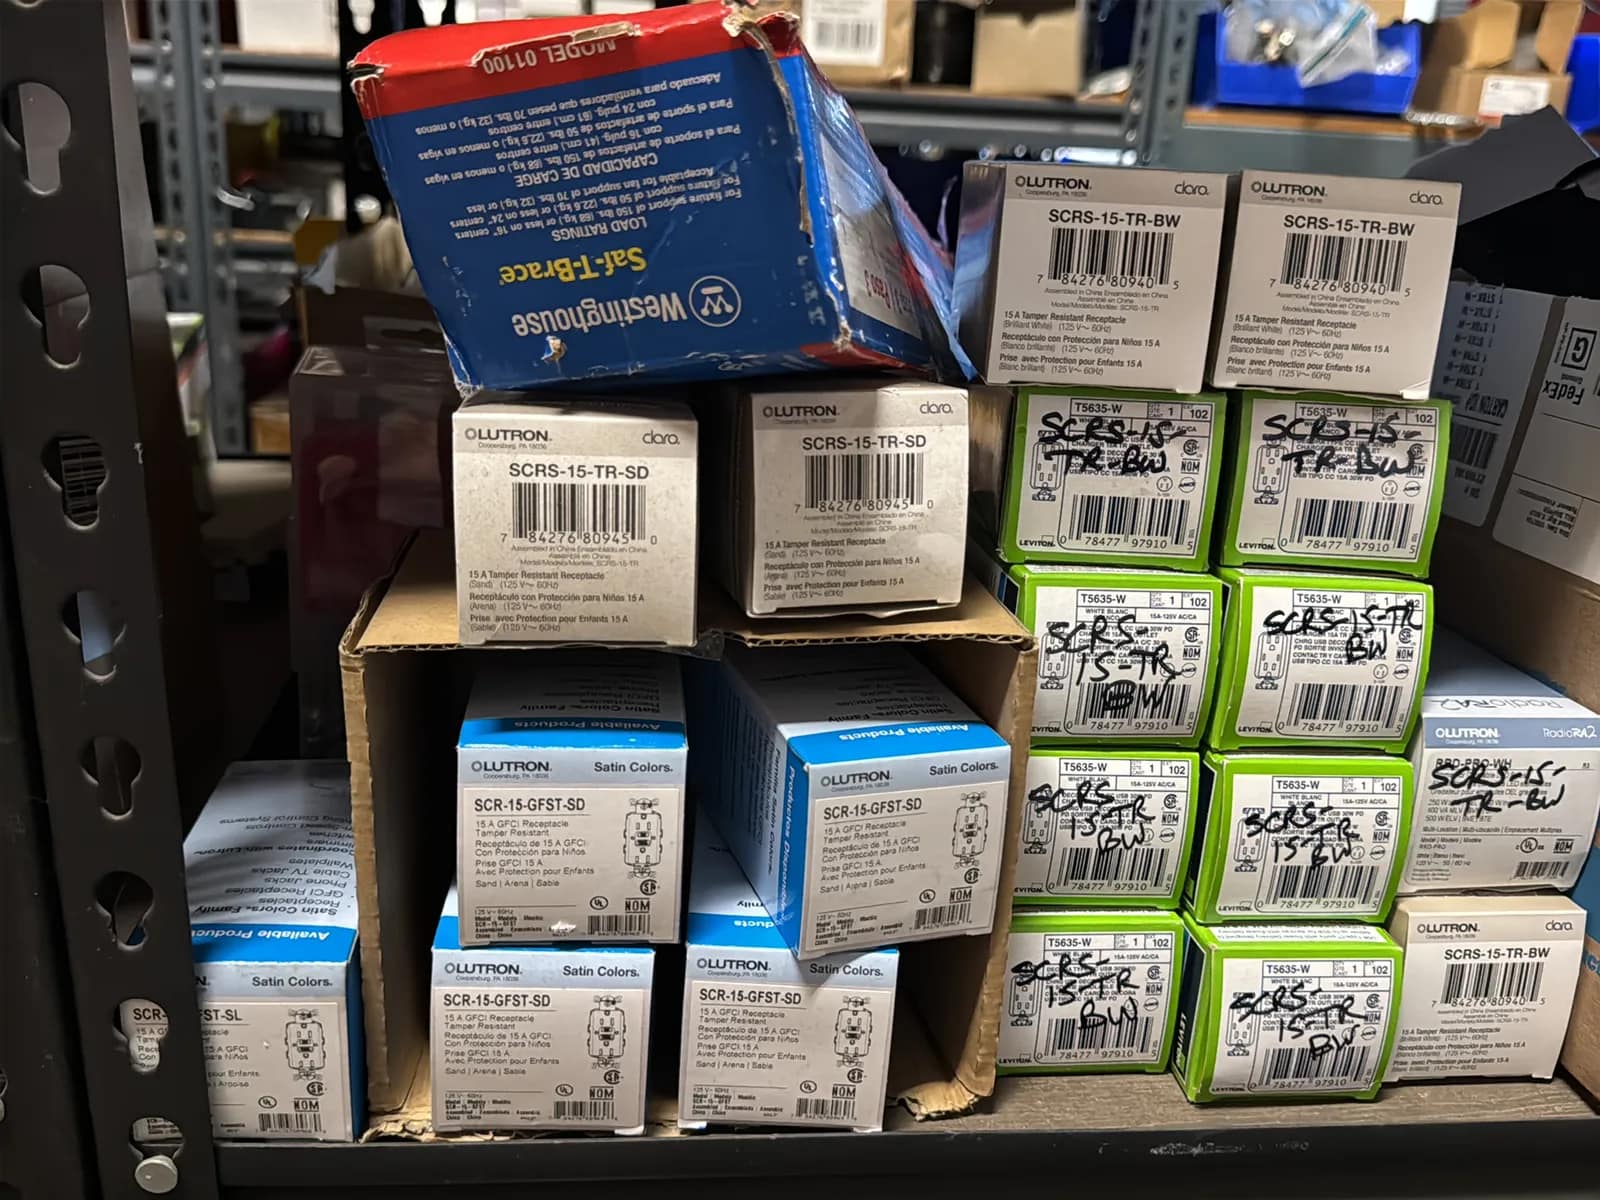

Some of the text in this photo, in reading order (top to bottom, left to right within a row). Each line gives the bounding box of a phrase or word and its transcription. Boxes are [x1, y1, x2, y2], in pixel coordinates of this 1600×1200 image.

[482, 50, 537, 75] 01100
[643, 80, 668, 95] para
[669, 71, 721, 91] Adecuado
[579, 88, 642, 107] ventiladores
[527, 103, 558, 117] pesen
[559, 98, 578, 112] que
[477, 114, 492, 128] (32
[495, 111, 512, 123] lbs.
[513, 109, 526, 120] 70
[415, 122, 448, 136] menos
[458, 117, 477, 131] kg.)
[513, 152, 659, 188] CAPACIDAD DE CARGE
[1048, 209, 1181, 228] SCRS-15-TR-BW
[550, 215, 648, 241] LOAD RATINGS
[1283, 215, 1415, 237] SCRS-15-TR-BW
[1061, 274, 1154, 289] 84276 80940
[1293, 279, 1386, 296] 84276 80940
[511, 291, 688, 338] Westinghouse
[1571, 337, 1589, 363] G
[1542, 380, 1585, 406] FedEx
[1074, 402, 1209, 419] T5635-W 102
[1300, 406, 1434, 424] T5635-W 102
[802, 435, 926, 450] SCRS-15-TR-SD
[508, 463, 650, 479] SCRS-15-TR-SD
[819, 498, 909, 512] 84276 80945
[528, 531, 629, 544] 84276 80945
[1084, 536, 1167, 549] 78477 97910
[1306, 540, 1390, 552] 78477 97910
[469, 571, 480, 579] 15
[489, 571, 519, 580] Tamper
[520, 571, 559, 580] Resistant
[560, 572, 605, 581] Receptacle
[1080, 593, 1208, 607] T5635-W 102
[1297, 593, 1342, 604] T5635-W
[1346, 629, 1388, 663] BW
[514, 720, 661, 731] Available Products
[1090, 721, 1168, 731] 78477 97910
[1301, 723, 1379, 733] 78477 97910
[839, 724, 969, 741] Available Products
[594, 762, 626, 773] Satin
[929, 765, 957, 776] Satin
[1064, 762, 1186, 775] T5635-W 102
[1276, 780, 1397, 791] T5635-W 102
[474, 798, 585, 811] SCR-15-GFST-SD
[784, 765, 796, 838] Productos
[823, 798, 922, 820] SCR-15-GFST-SD
[476, 820, 486, 828] 15
[497, 820, 519, 828] GFCI
[522, 820, 569, 830] Receptacle
[476, 829, 507, 838] Tamper
[1097, 822, 1145, 856] BW
[288, 859, 354, 870] Wallplates
[263, 877, 348, 888] Phone Jacks
[1114, 883, 1147, 891] 97910
[225, 886, 344, 898] GFCI Receptacles
[257, 897, 341, 907] Receptacles
[1280, 901, 1355, 909] 78477 97910
[194, 905, 241, 915] Family
[301, 906, 338, 916] Satin
[258, 930, 330, 941] Available
[1048, 938, 1169, 947] T5635-W 102
[1444, 947, 1550, 960] SCRS-15-TR-BW
[563, 966, 594, 977] Satin
[809, 963, 839, 974] Satin
[1266, 964, 1389, 975] T5635-W 102
[252, 976, 284, 987] Satin
[443, 994, 551, 1007] SCR-15-GFST-SD
[699, 988, 802, 1005] SCR-15-GFST-SD
[1451, 997, 1526, 1007] 84276 80940
[1078, 996, 1138, 1030] BW
[1309, 1024, 1360, 1060] BW
